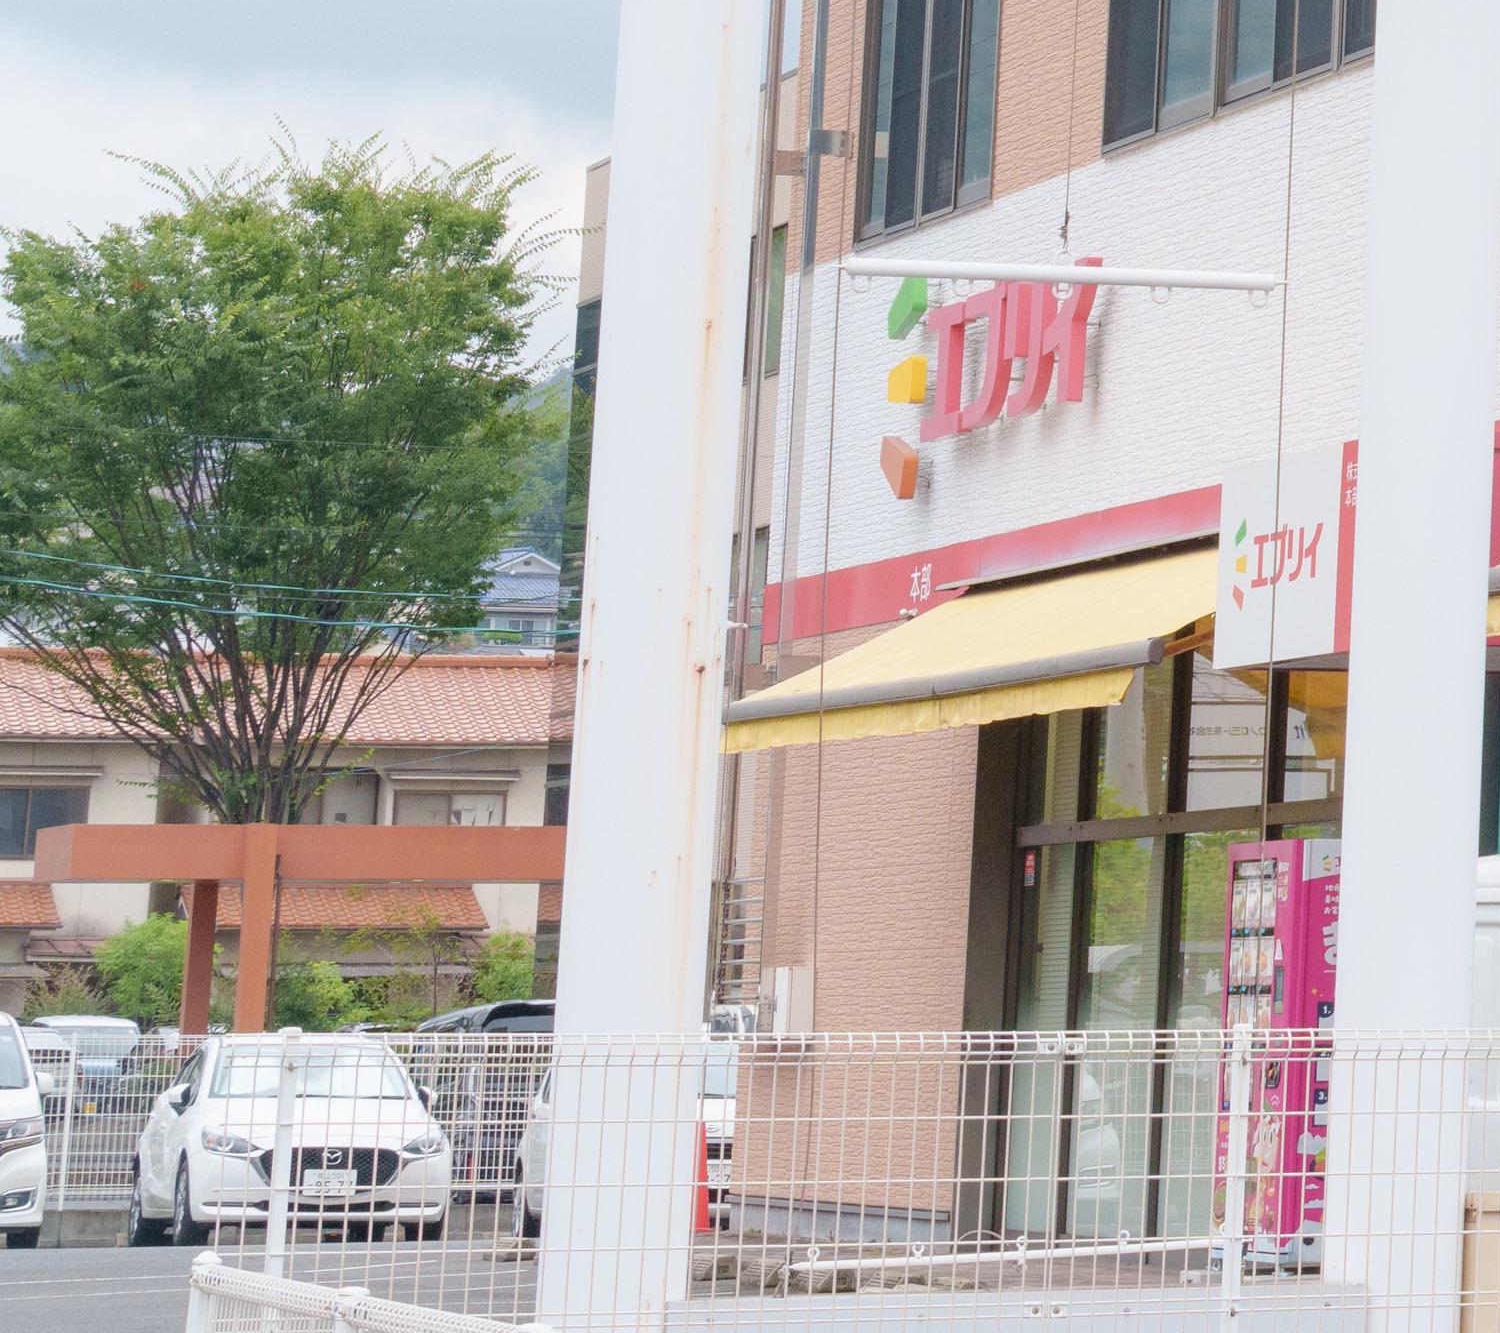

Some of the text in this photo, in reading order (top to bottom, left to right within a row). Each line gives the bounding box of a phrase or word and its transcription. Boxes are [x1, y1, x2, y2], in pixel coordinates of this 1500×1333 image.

[1251, 521, 1325, 590] エブリイ
[909, 563, 932, 603] 本部
